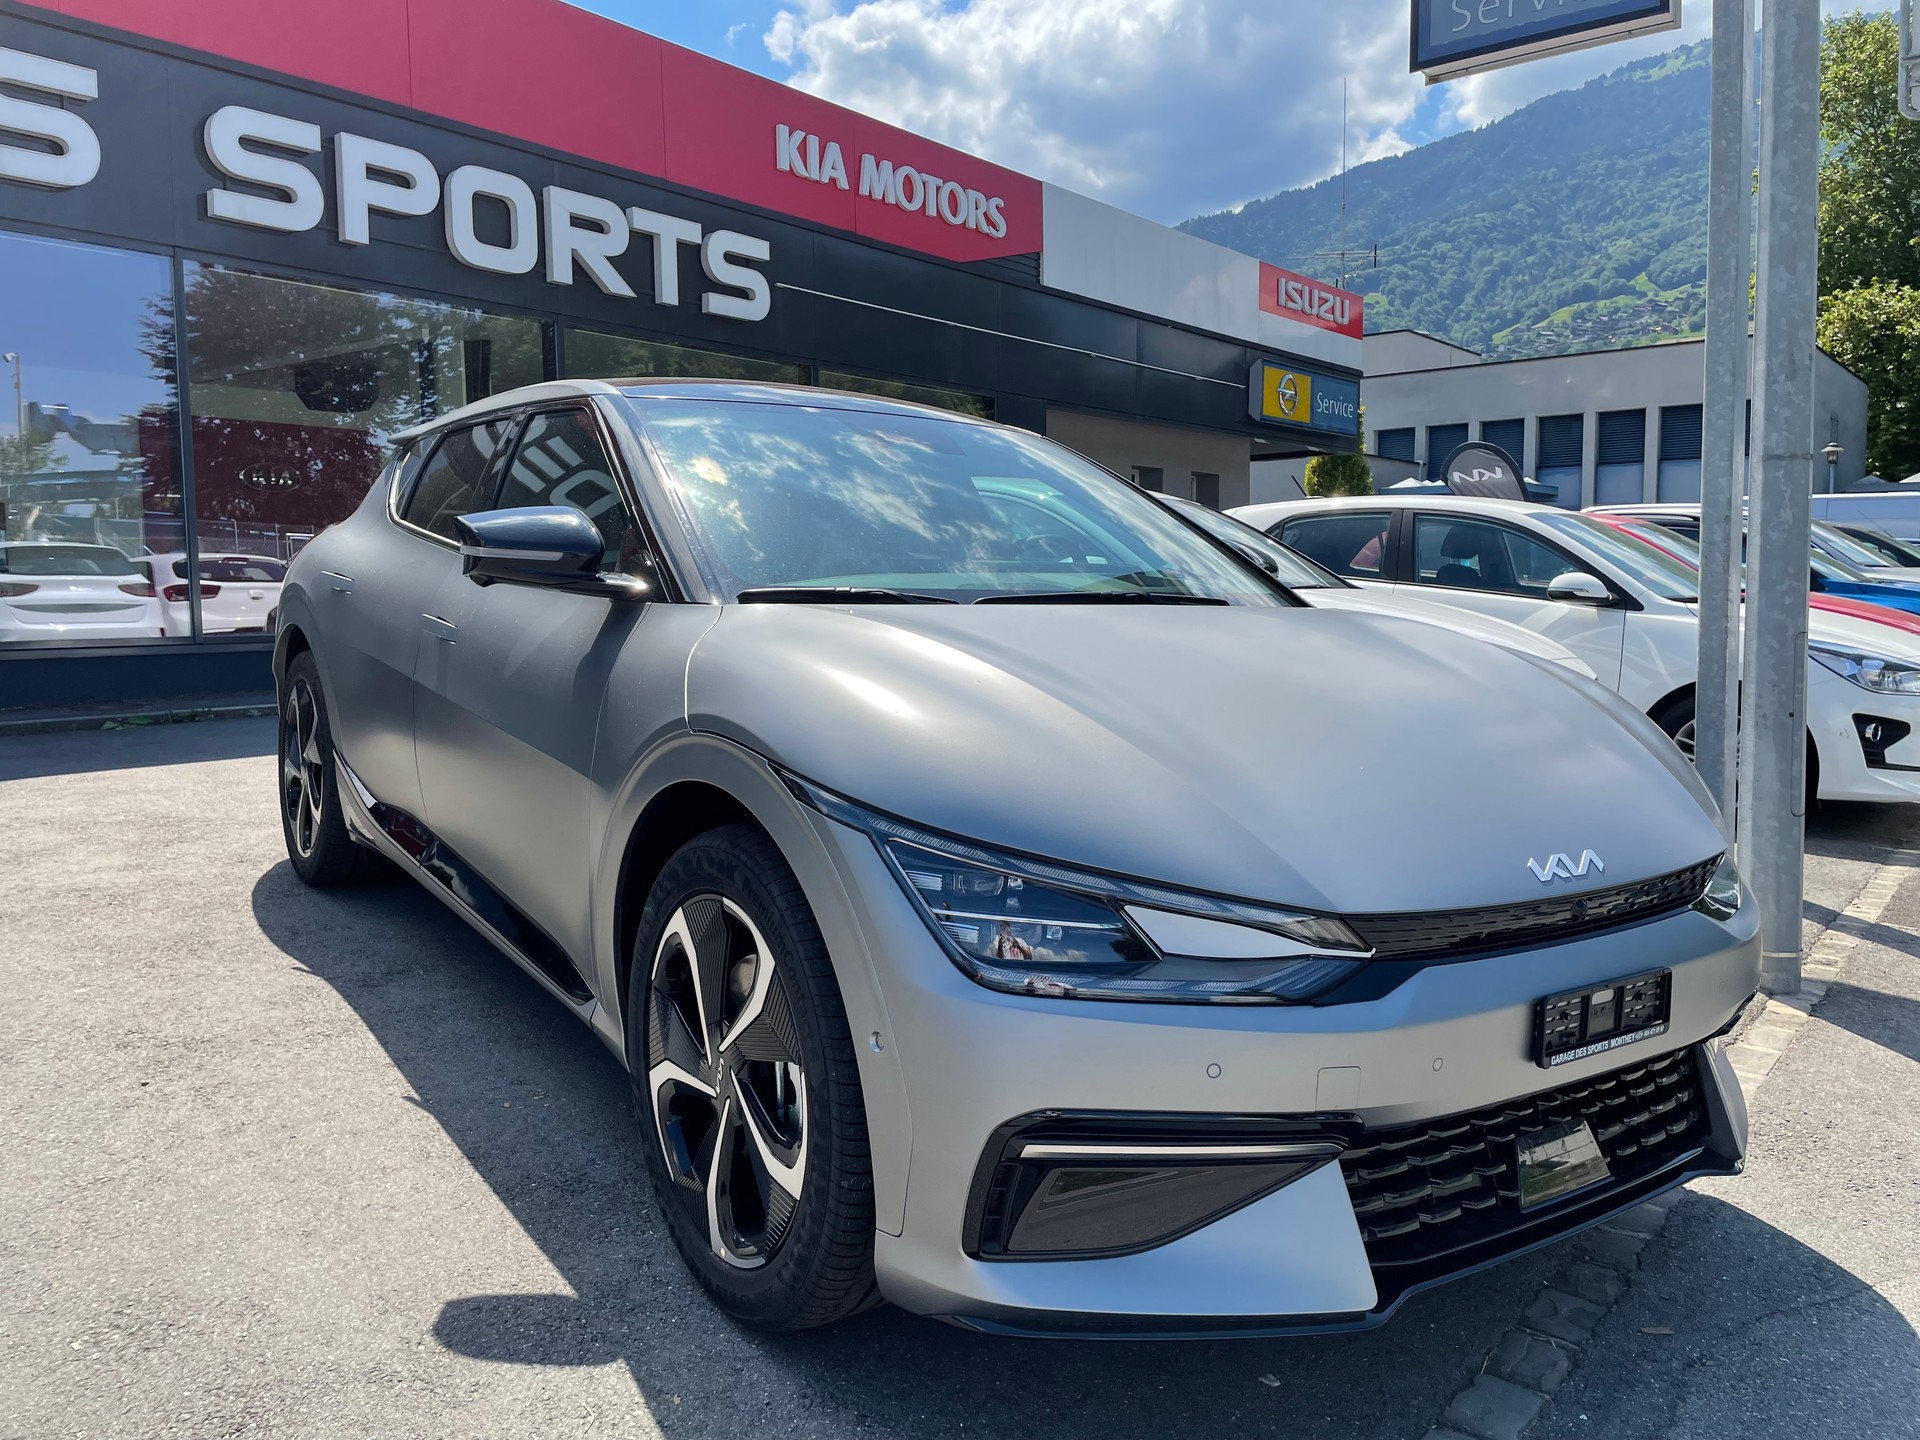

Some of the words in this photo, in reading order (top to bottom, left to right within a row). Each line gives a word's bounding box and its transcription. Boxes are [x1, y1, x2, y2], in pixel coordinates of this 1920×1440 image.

[776, 123, 850, 190] KIA
[859, 153, 1007, 239] MOTORS
[204, 105, 771, 322] SPORTS
[1277, 277, 1350, 326] ISUZU
[1317, 392, 1354, 419] Service
[1551, 1049, 1576, 1065] GARAGE
[1575, 1046, 1587, 1061] DES
[1587, 1040, 1609, 1056] SPORTS
[1610, 1033, 1636, 1049] MONTHEY
